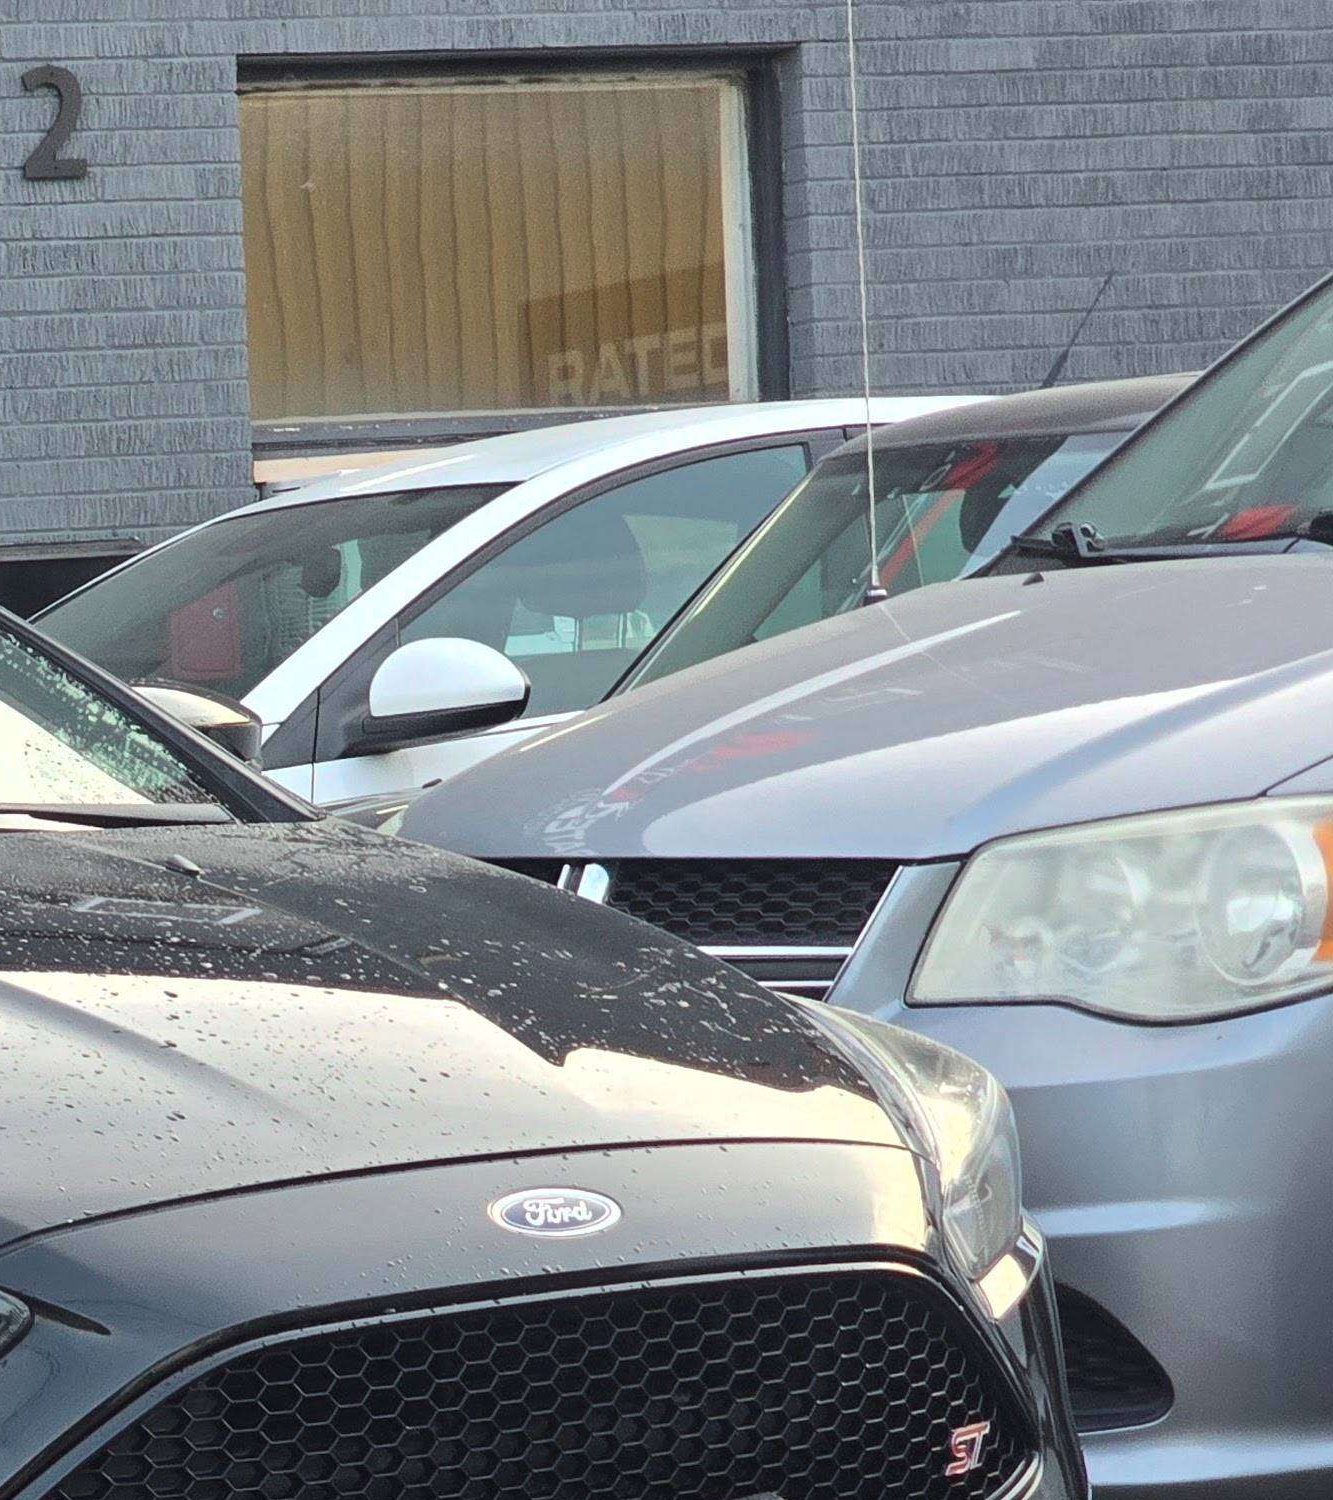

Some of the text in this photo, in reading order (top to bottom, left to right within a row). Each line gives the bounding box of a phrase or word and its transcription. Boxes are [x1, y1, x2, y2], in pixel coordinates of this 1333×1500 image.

[21, 64, 87, 180] 2
[523, 1197, 593, 1226] Ford
[945, 1421, 990, 1476] ST
